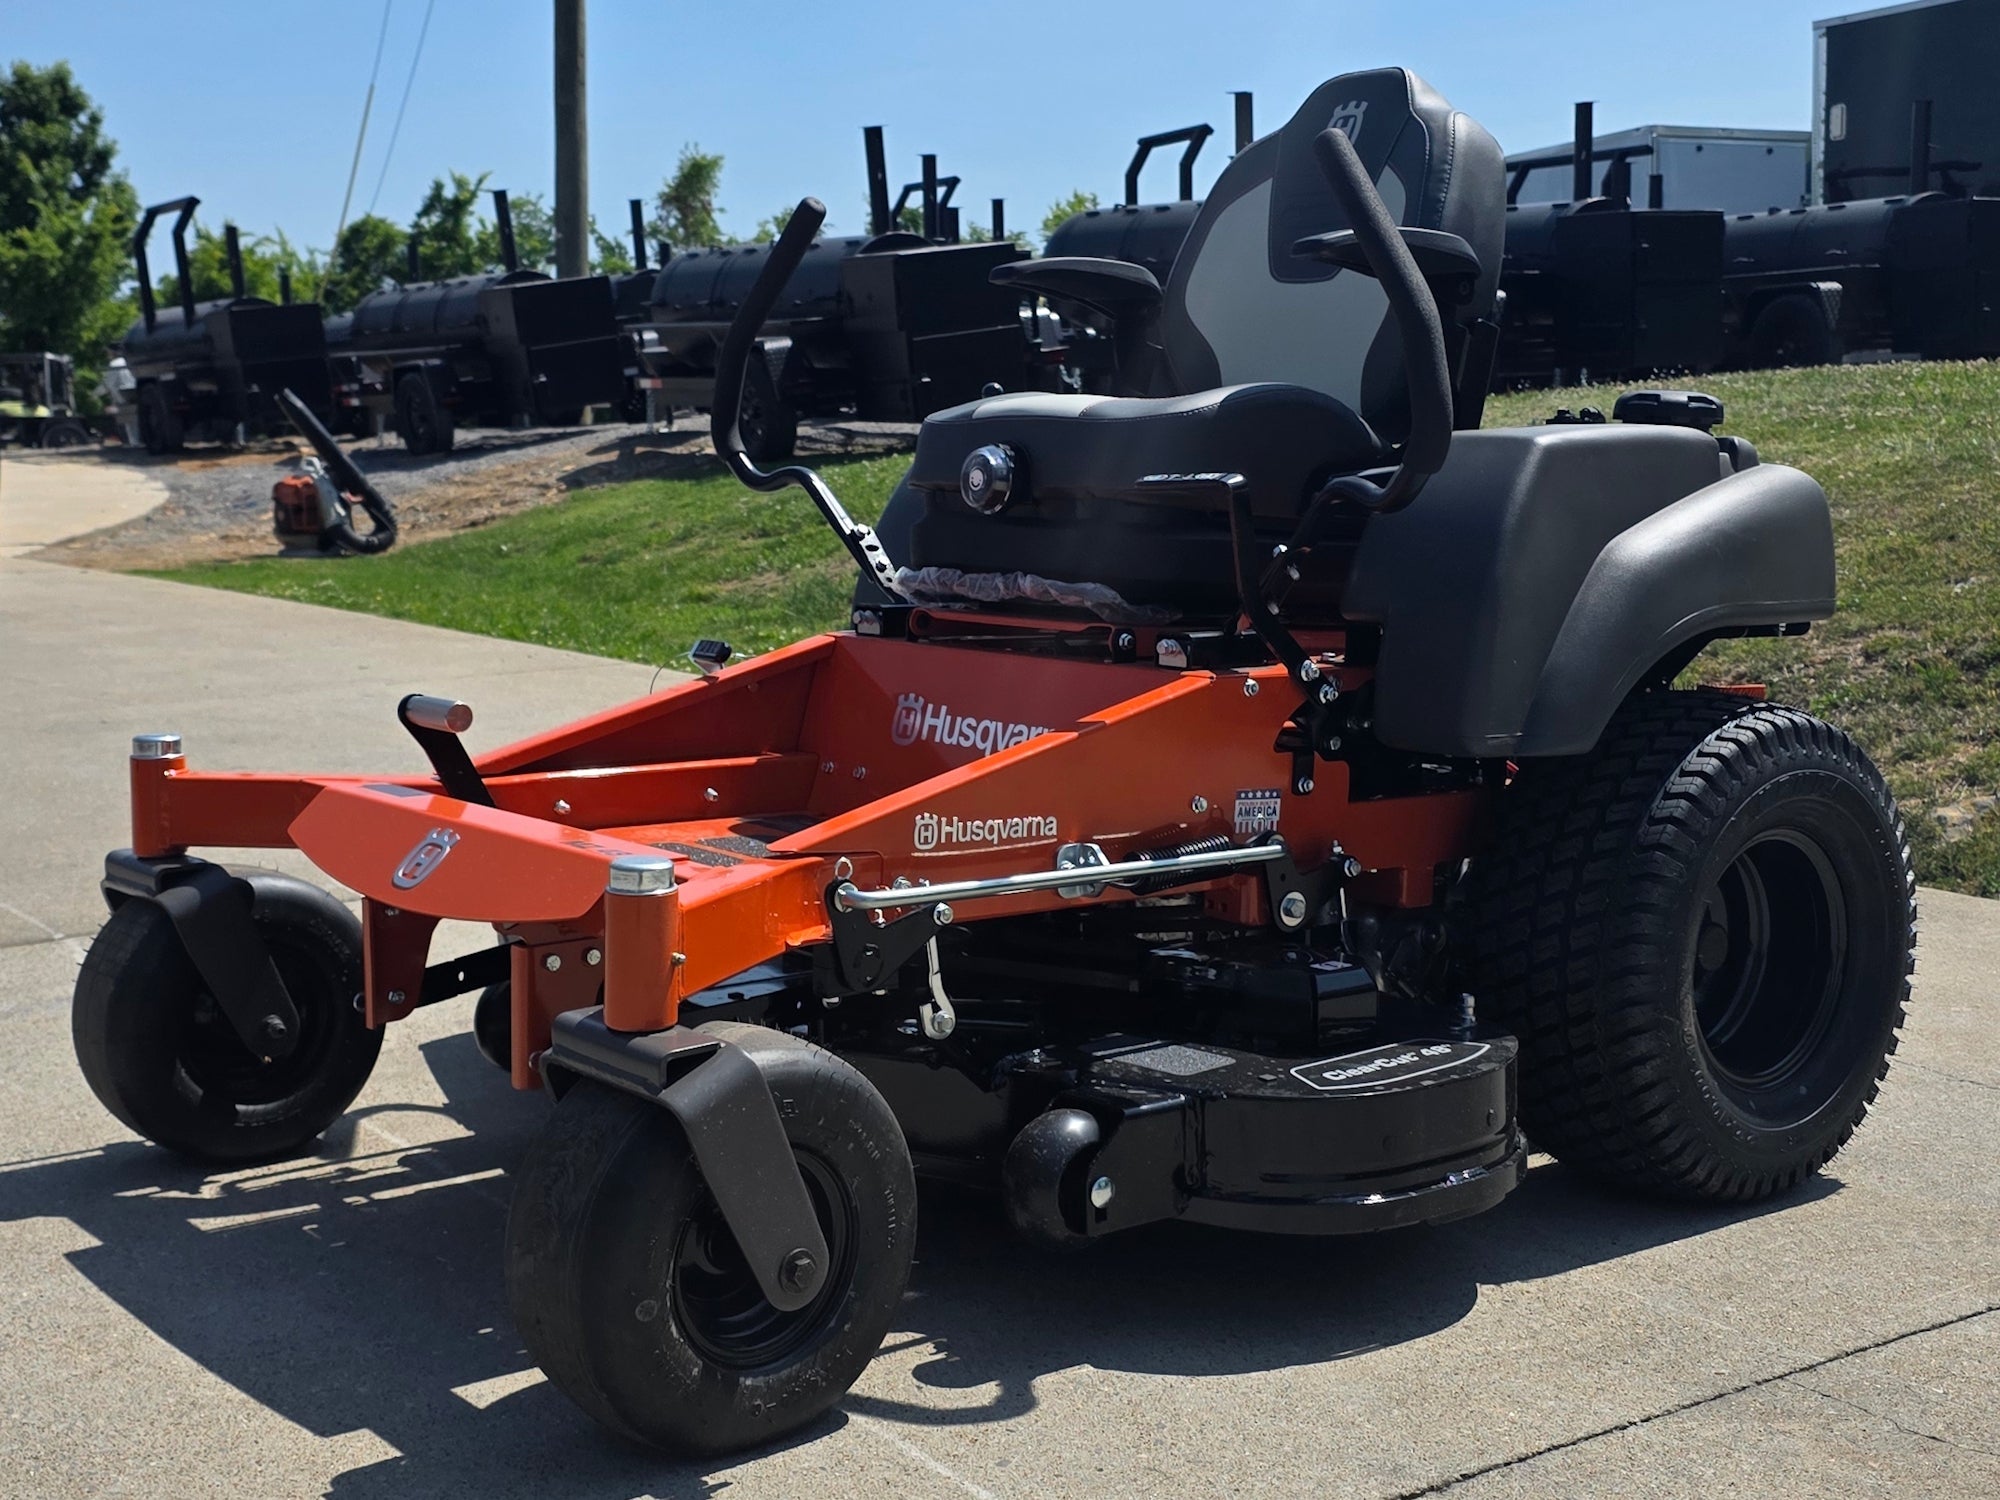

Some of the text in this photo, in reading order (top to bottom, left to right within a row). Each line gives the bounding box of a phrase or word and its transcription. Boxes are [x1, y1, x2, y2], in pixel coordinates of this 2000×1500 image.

[921, 703, 1055, 757] Husqvar
[1237, 805, 1277, 818] AMERICA
[940, 816, 1058, 844] Husqvarna
